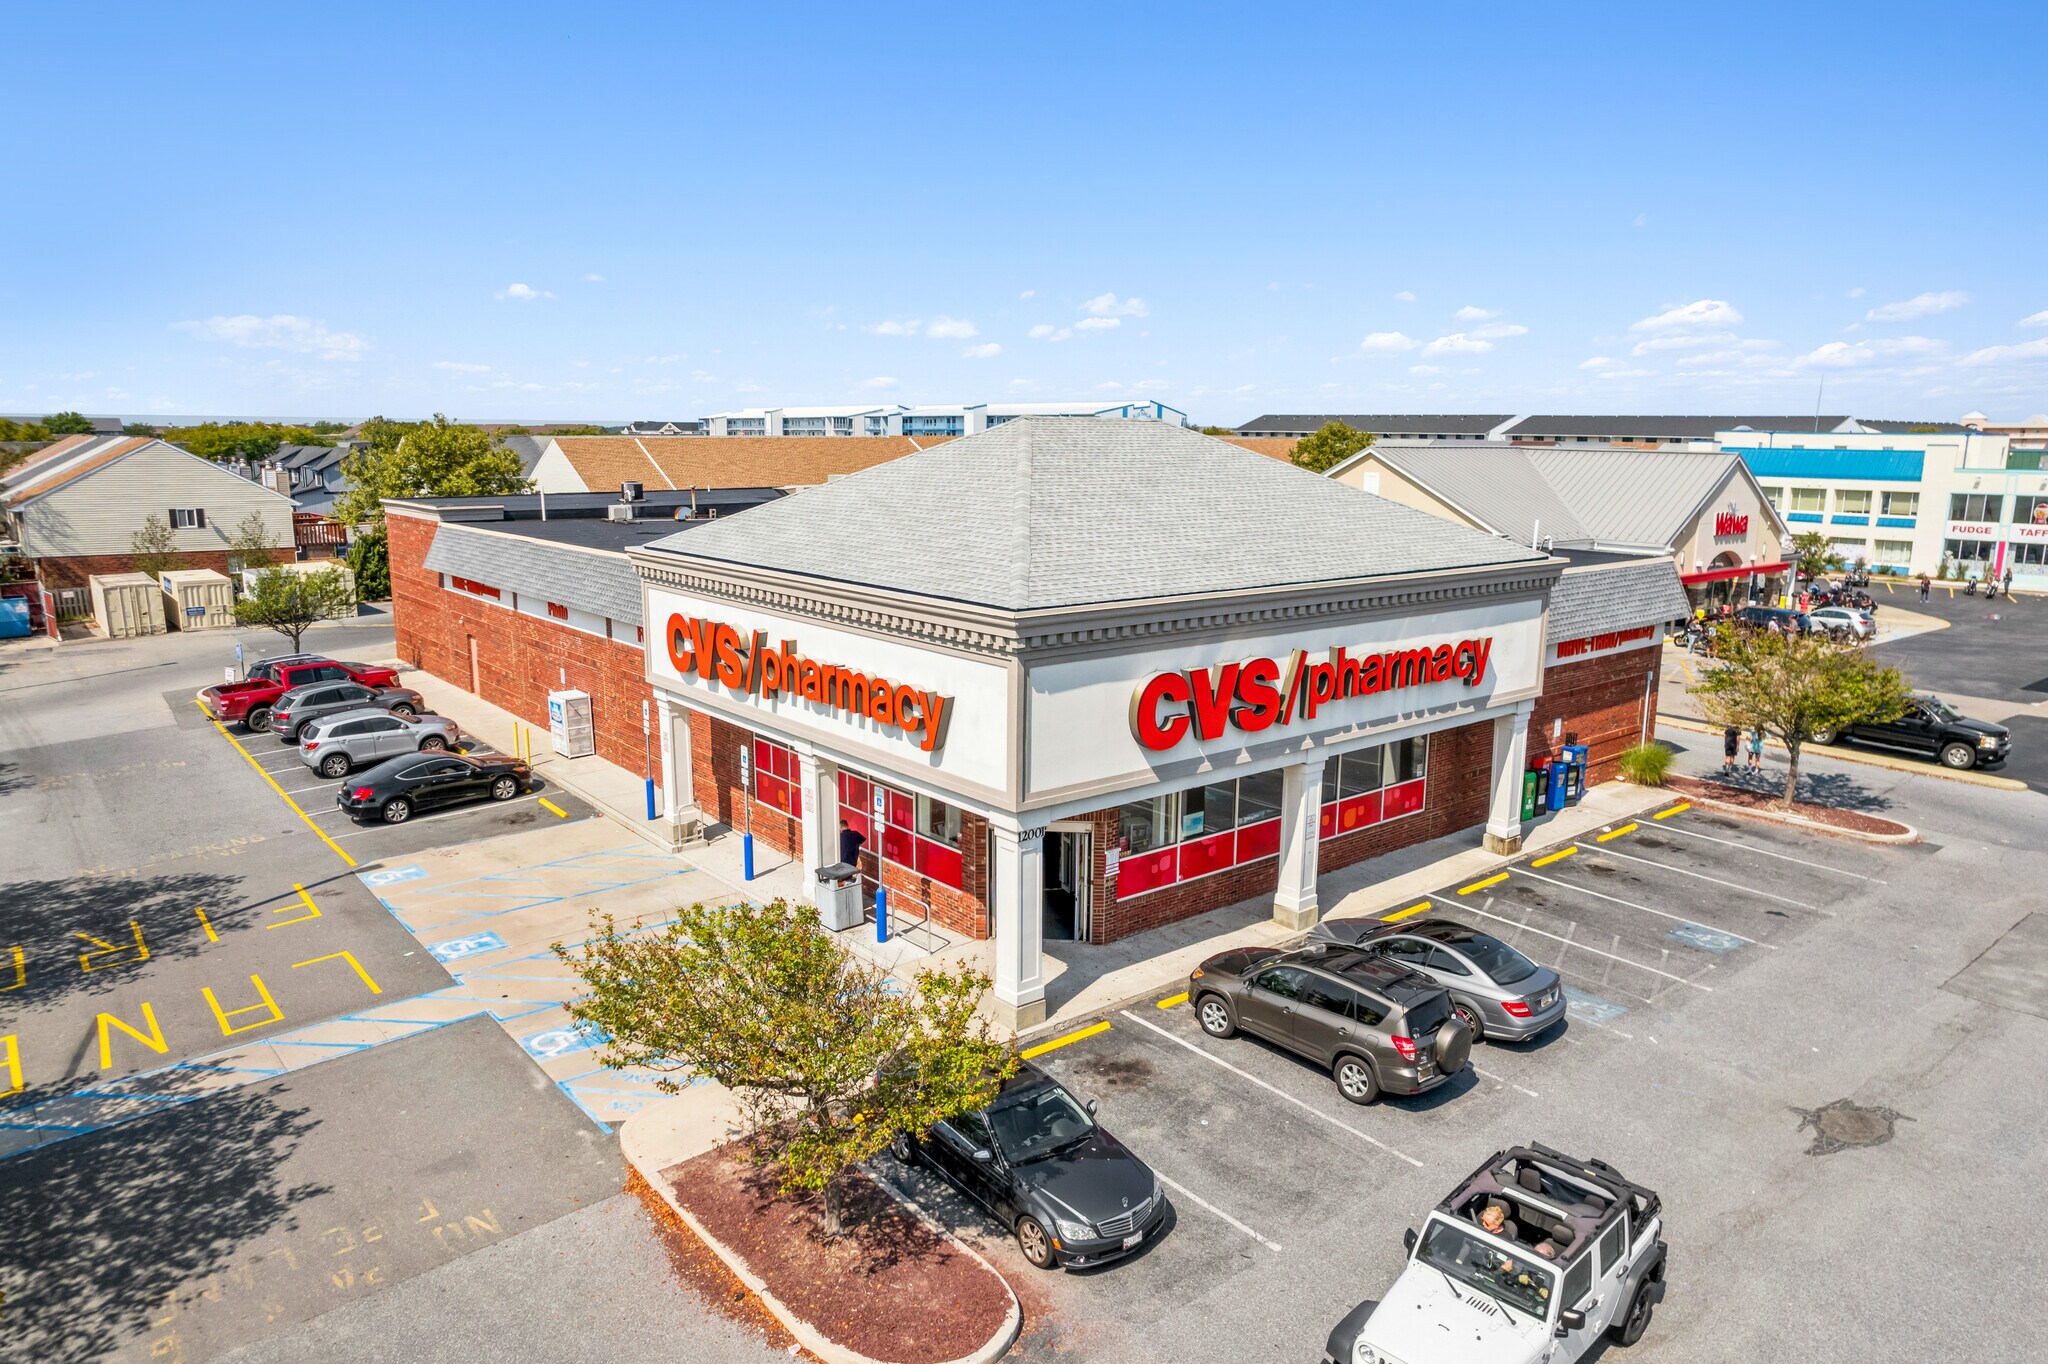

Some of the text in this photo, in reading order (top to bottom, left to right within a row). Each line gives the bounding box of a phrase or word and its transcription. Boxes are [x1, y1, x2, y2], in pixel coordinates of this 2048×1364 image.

[1715, 512, 1749, 536] Wawa
[1951, 525, 1993, 535] FUDGE
[667, 612, 954, 752] CVS/pharmacy
[1132, 637, 1492, 751] CVS/pharmacy
